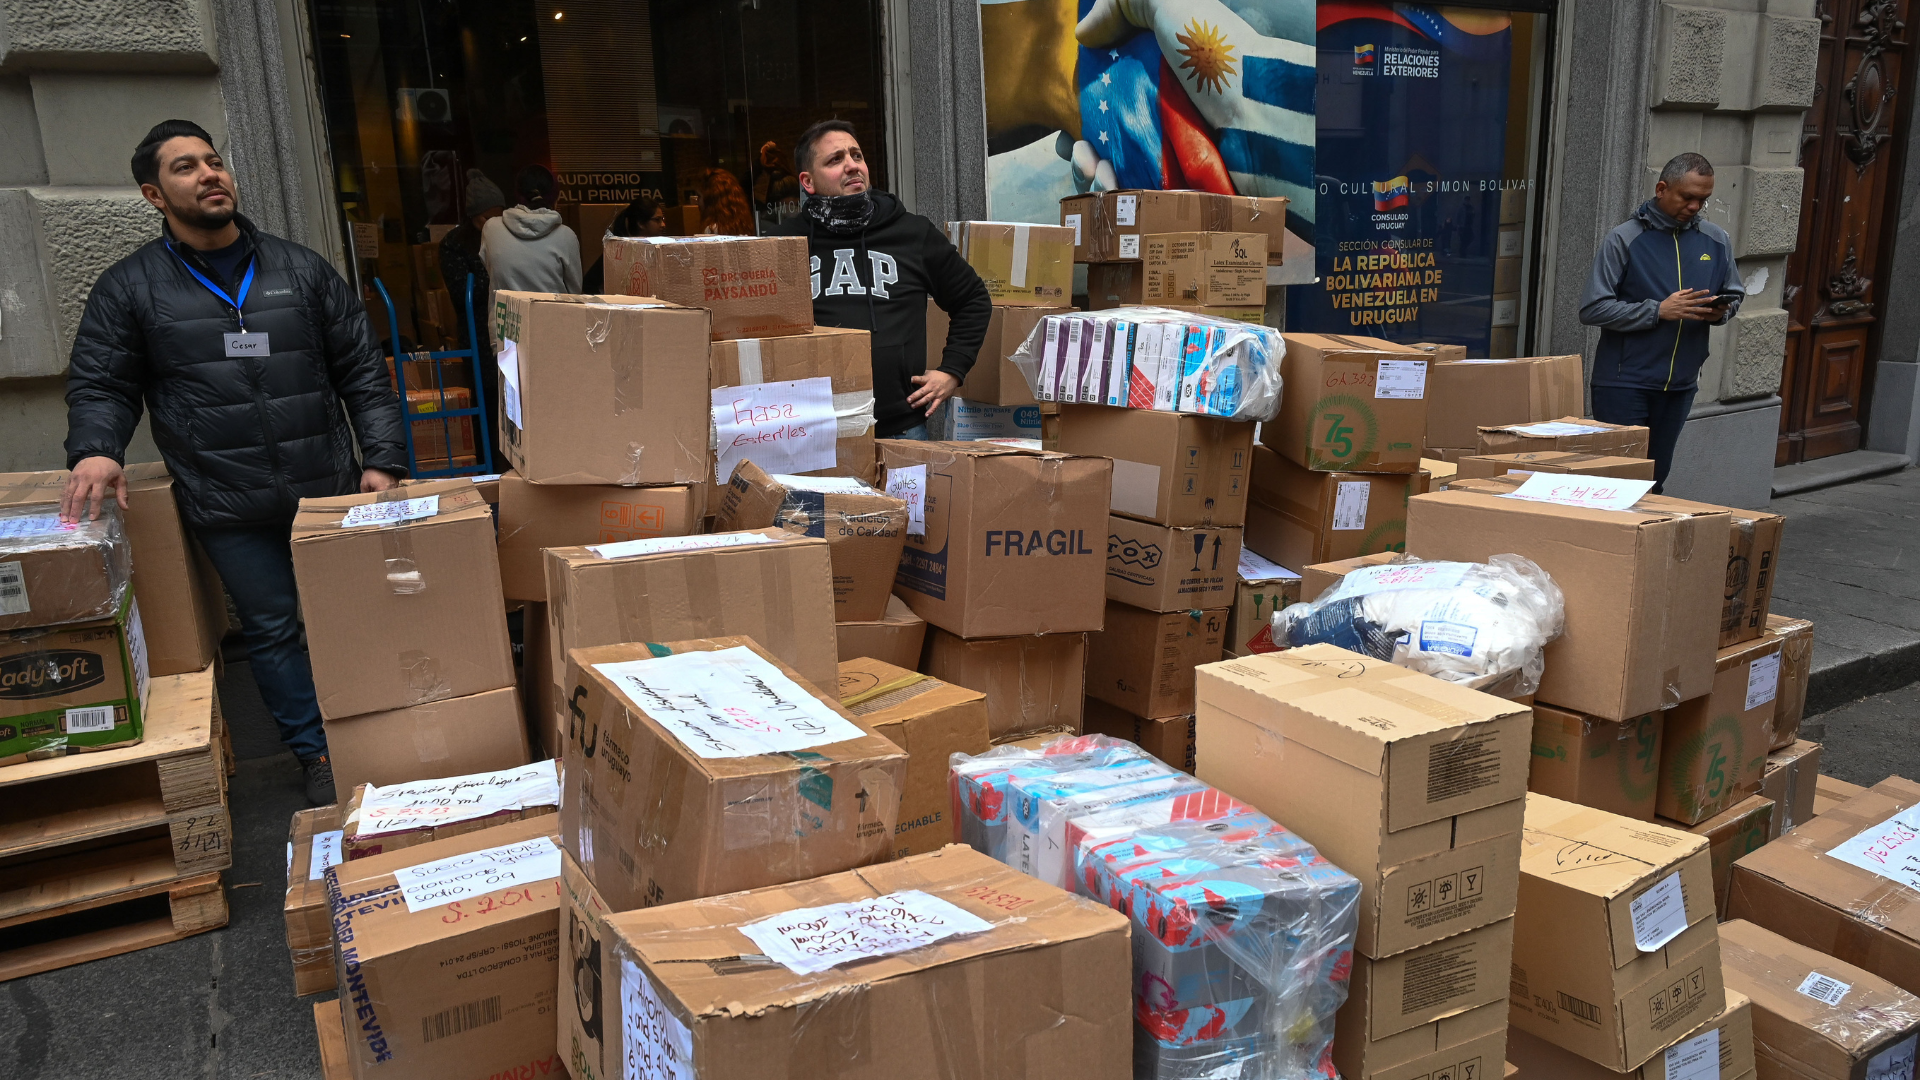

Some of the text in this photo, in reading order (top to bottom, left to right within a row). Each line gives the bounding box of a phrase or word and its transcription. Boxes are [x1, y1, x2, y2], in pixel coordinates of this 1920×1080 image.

[1384, 53, 1440, 66] RELACIONES
[1383, 65, 1439, 78] EXTERIORES
[557, 173, 641, 185] AUDITORIO
[1340, 180, 1416, 195] CULTURAL
[1426, 179, 1470, 194] SIMON
[1479, 178, 1536, 192] BOLIVAR
[557, 190, 582, 201] ALI
[1371, 213, 1409, 222] CONSULADO
[1375, 222, 1405, 230] URUGUAY
[1338, 238, 1433, 251] SECCIÓN CONSULAR DE
[1234, 248, 1248, 259] SQL
[1333, 250, 1436, 272] LA REPÚBLICA
[809, 248, 899, 300] GAP
[1326, 269, 1443, 291] BOLIVARIANA DE
[703, 279, 778, 301] PAYSANDÚ
[1332, 288, 1438, 309] VENEZUELA EN
[1350, 307, 1419, 326] URUGUAY
[231, 340, 257, 350] Cesar
[1020, 410, 1038, 419] 049
[1323, 413, 1354, 458] 75
[838, 526, 899, 538] de Calidad
[985, 529, 1093, 557] FRAGIL
[1109, 566, 1127, 575] CALIDAD
[567, 685, 598, 758] fu
[602, 730, 630, 766] fármaco
[601, 746, 632, 784] uruguayo
[1706, 742, 1728, 798] 75
[895, 812, 942, 835] ECHABLE
[501, 937, 526, 949] TIOSSI
[528, 928, 558, 943] SIMONE
[466, 946, 495, 960] CRF/SP
[478, 956, 521, 974] COMÉRCIO
[456, 969, 477, 980] LTDA
